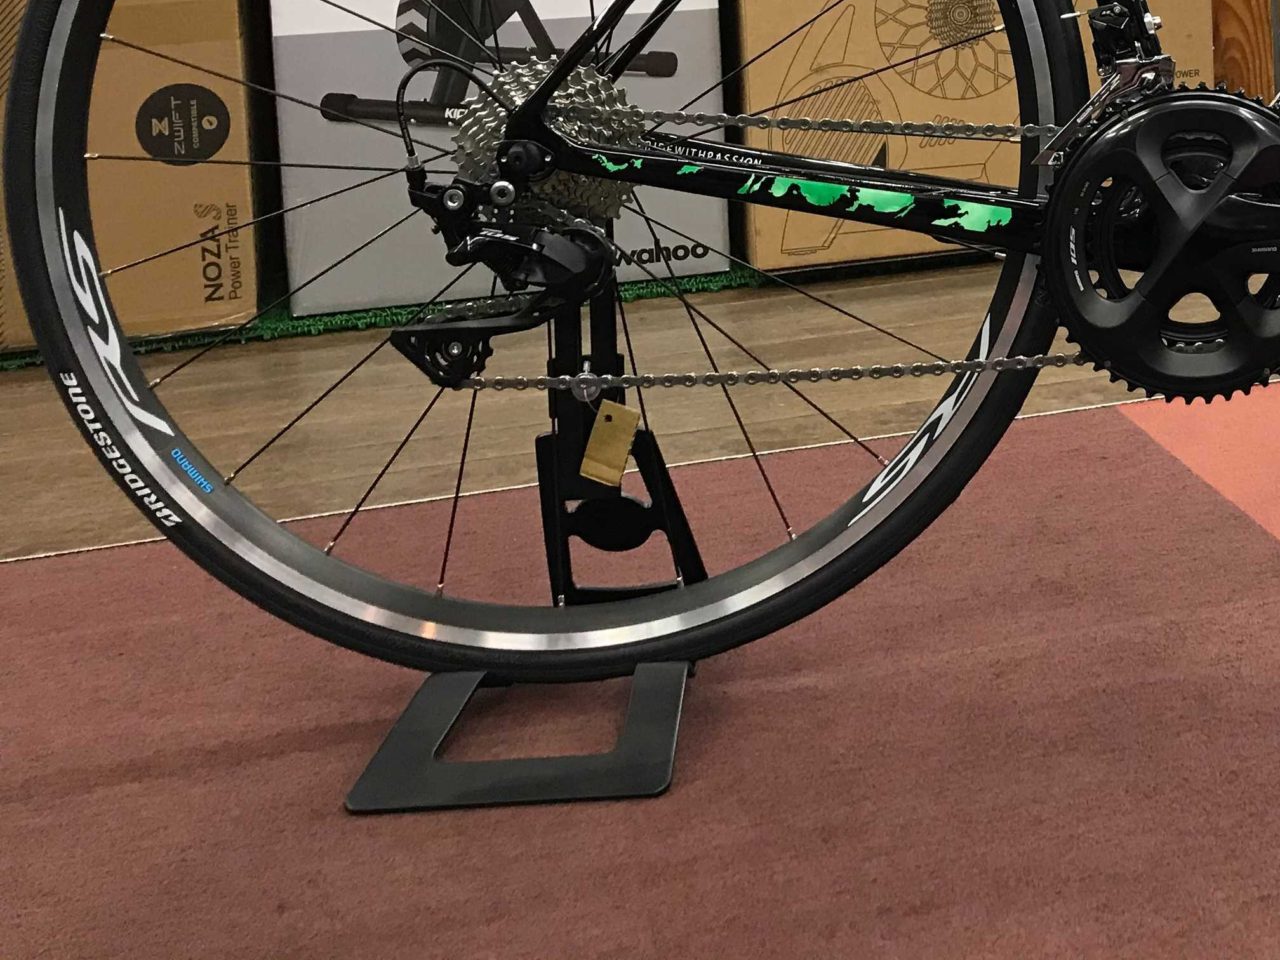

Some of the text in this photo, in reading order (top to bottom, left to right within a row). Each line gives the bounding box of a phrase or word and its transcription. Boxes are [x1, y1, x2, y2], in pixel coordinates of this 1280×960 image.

[1175, 69, 1200, 79] OWER
[170, 95, 186, 156] ZWIFT
[190, 99, 201, 149] COMPATIBLE
[193, 202, 225, 304] NOZA S
[225, 202, 243, 301] Power Trainer
[615, 238, 710, 268] wahoo
[59, 370, 184, 528] BRIDGESTONE
[171, 447, 214, 494] SHIMANO
